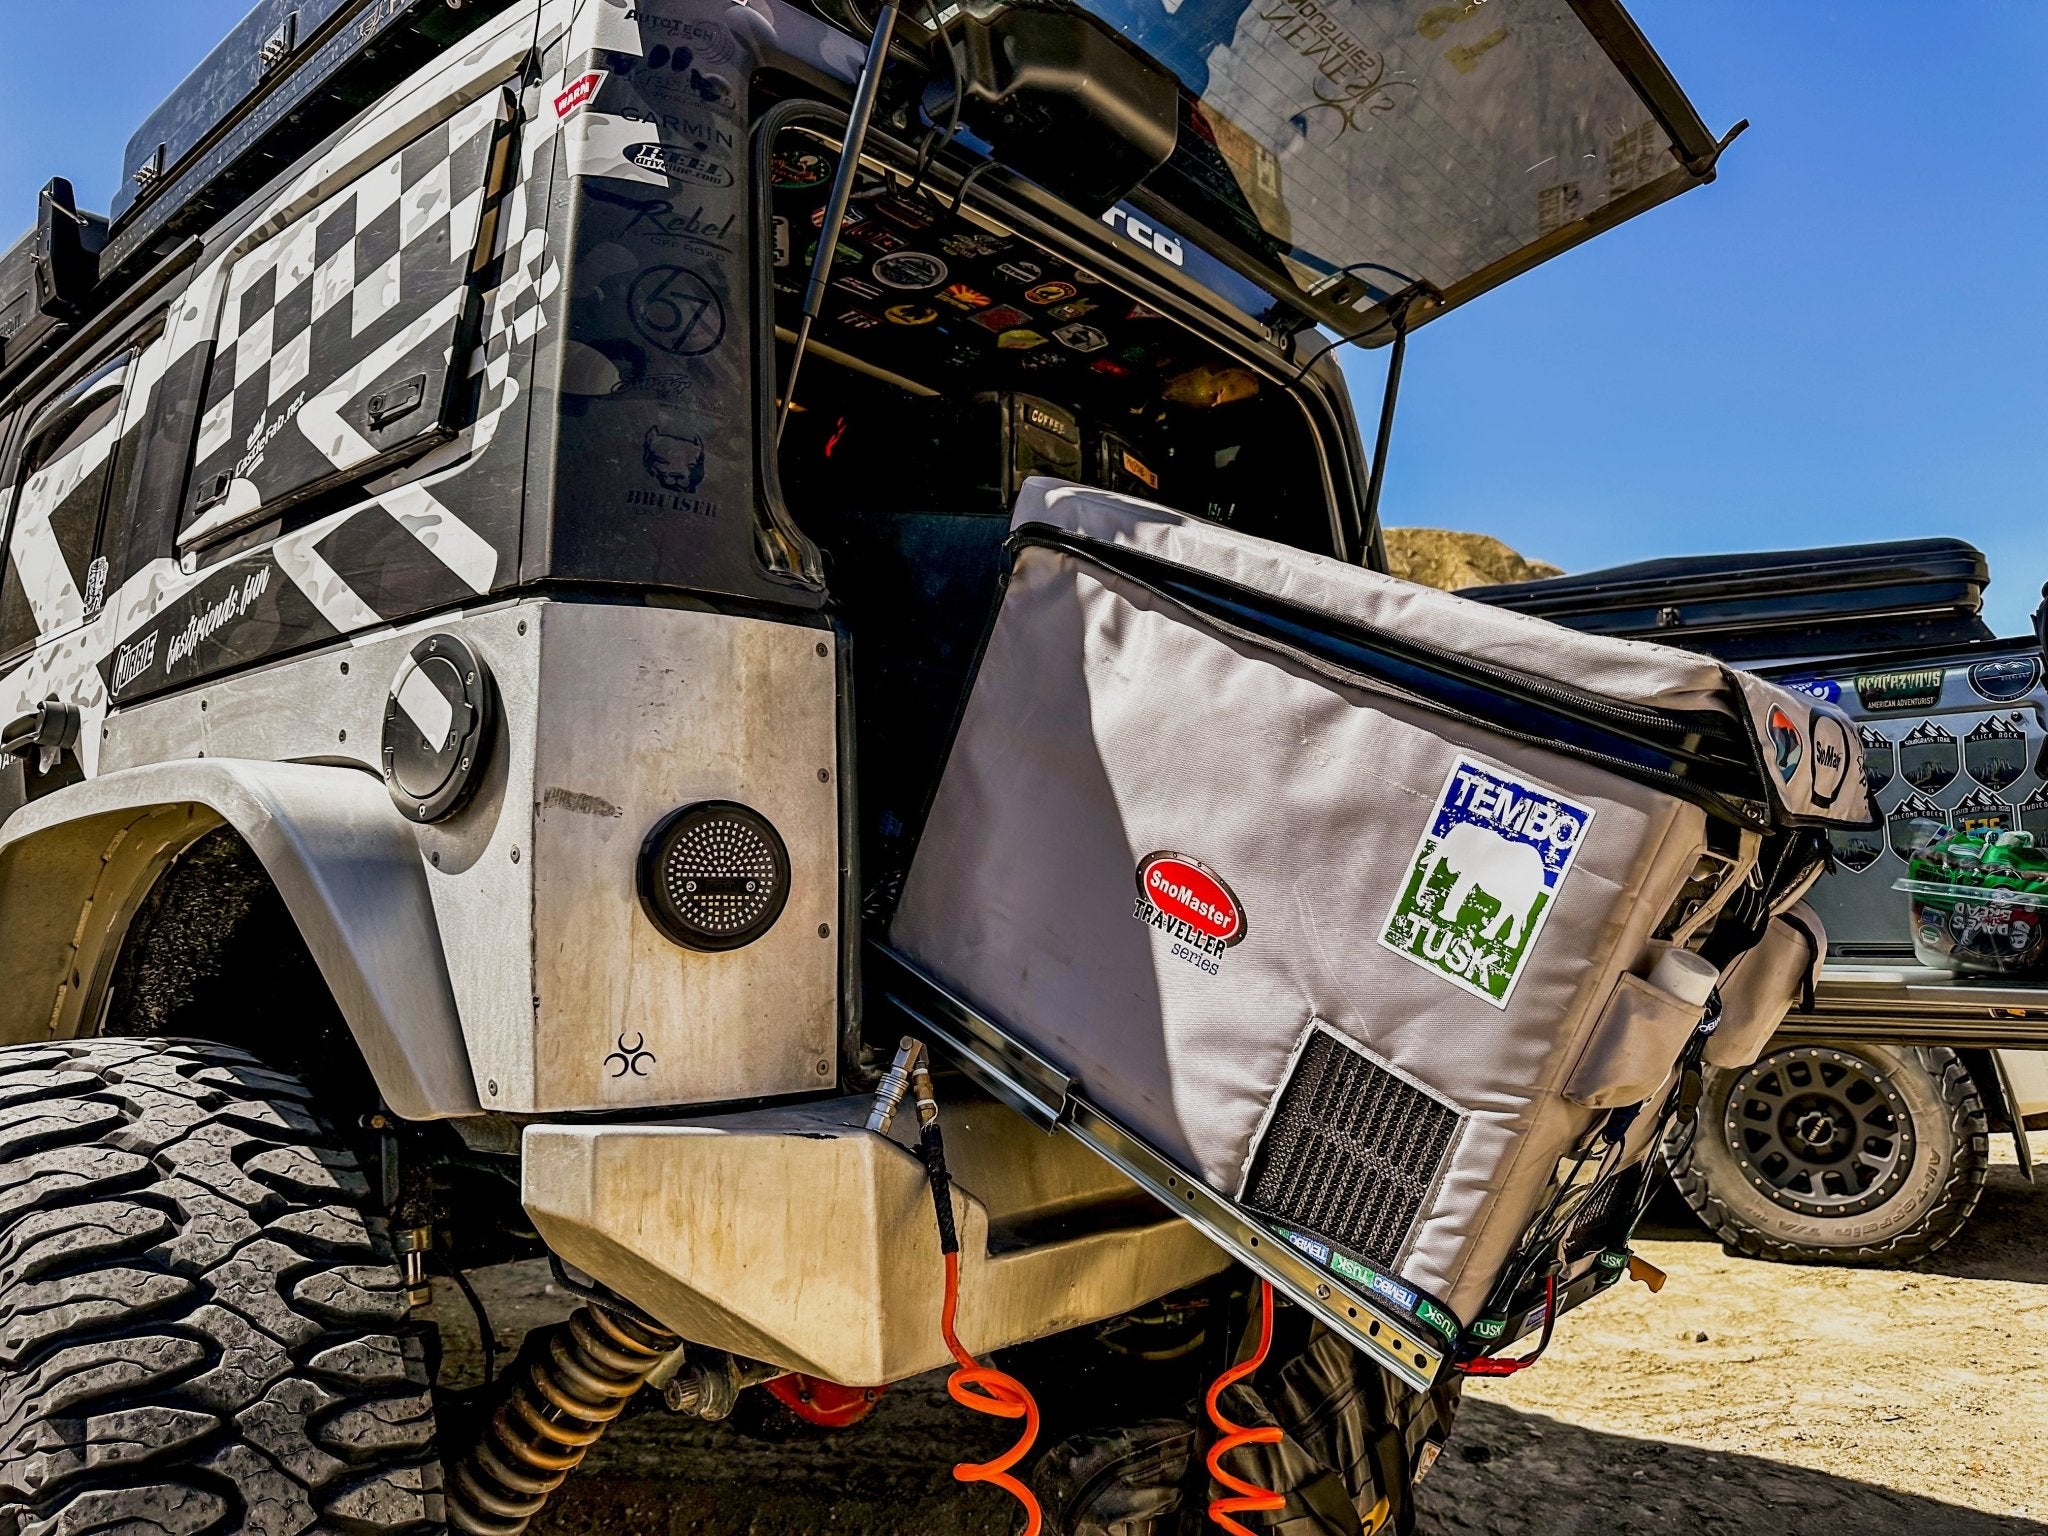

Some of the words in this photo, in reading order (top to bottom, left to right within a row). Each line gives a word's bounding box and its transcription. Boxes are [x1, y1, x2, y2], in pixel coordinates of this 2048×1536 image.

[558, 81, 591, 111] WARN
[621, 106, 733, 148] GARMIN
[618, 200, 736, 240] Rebel
[650, 237, 680, 249] OFF
[684, 244, 726, 263] ROAD
[235, 391, 305, 478] CastleFab.net
[627, 489, 718, 518] BRUISER
[112, 630, 159, 697] CURRIE
[1867, 699, 1896, 709] AMERICAN
[1897, 697, 1934, 707] ADVENTURIST
[1971, 732, 1993, 742] SLICK
[1998, 732, 2018, 740] ROCK
[1453, 770, 1581, 851] TEMBO
[1149, 868, 1233, 931] SnoMaster
[1955, 902, 2013, 921] BREAD
[1133, 897, 1228, 960] TRAVELLER
[1953, 915, 2010, 936] DAVE'S
[1170, 942, 1221, 976] series
[1407, 915, 1499, 991] TUSK
[1289, 1233, 1329, 1264] TEMBO
[1337, 1254, 1372, 1286] TUSK
[1373, 1273, 1414, 1310] TEMBO
